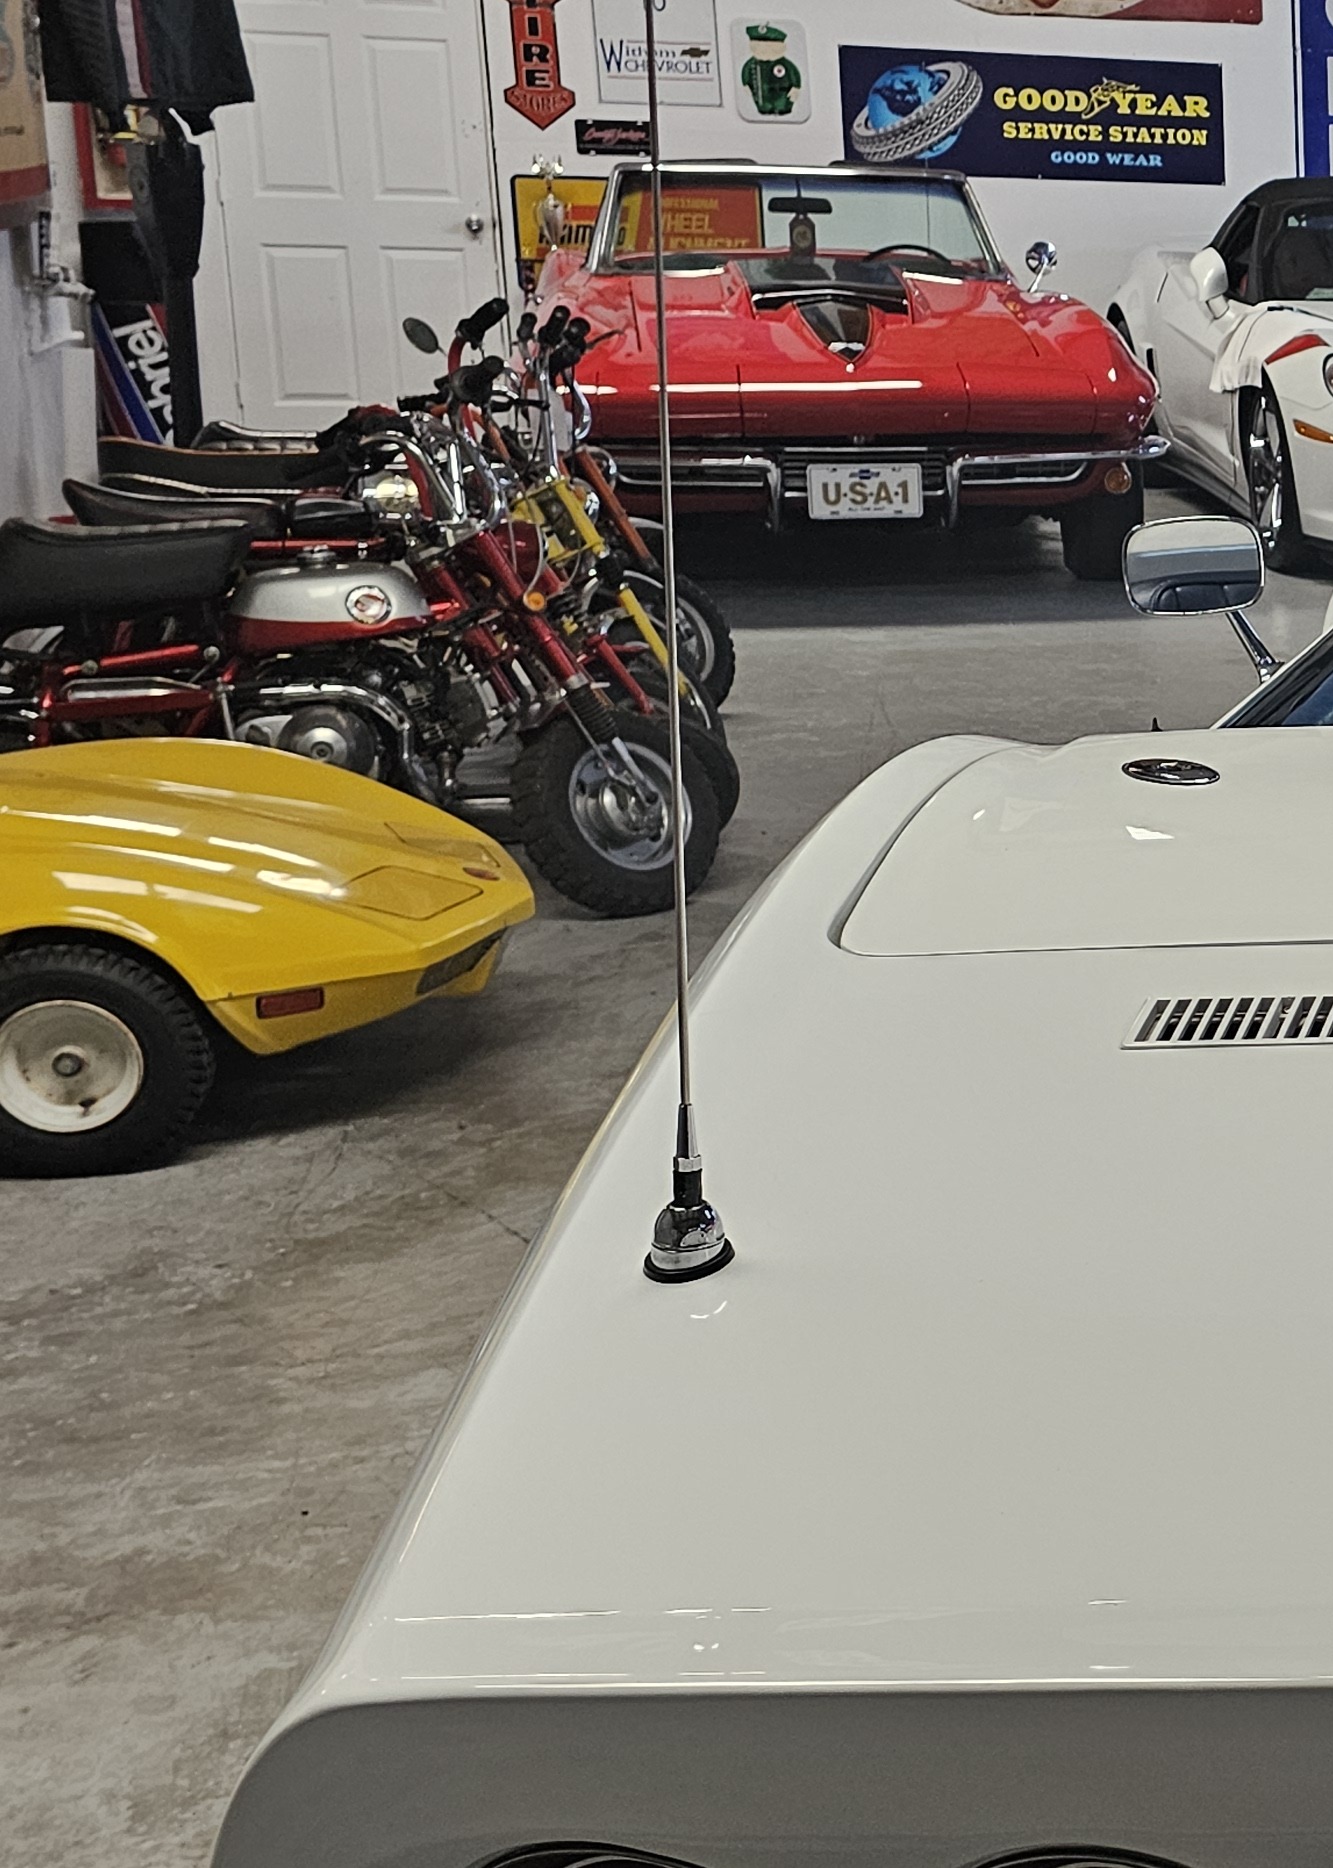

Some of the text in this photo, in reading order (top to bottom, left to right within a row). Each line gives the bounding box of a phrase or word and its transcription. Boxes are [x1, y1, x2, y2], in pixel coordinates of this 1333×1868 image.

[522, 0, 552, 88] IRE
[1002, 121, 1208, 146] SERVICE STATION
[1050, 150, 1163, 168] GOOD WEAR
